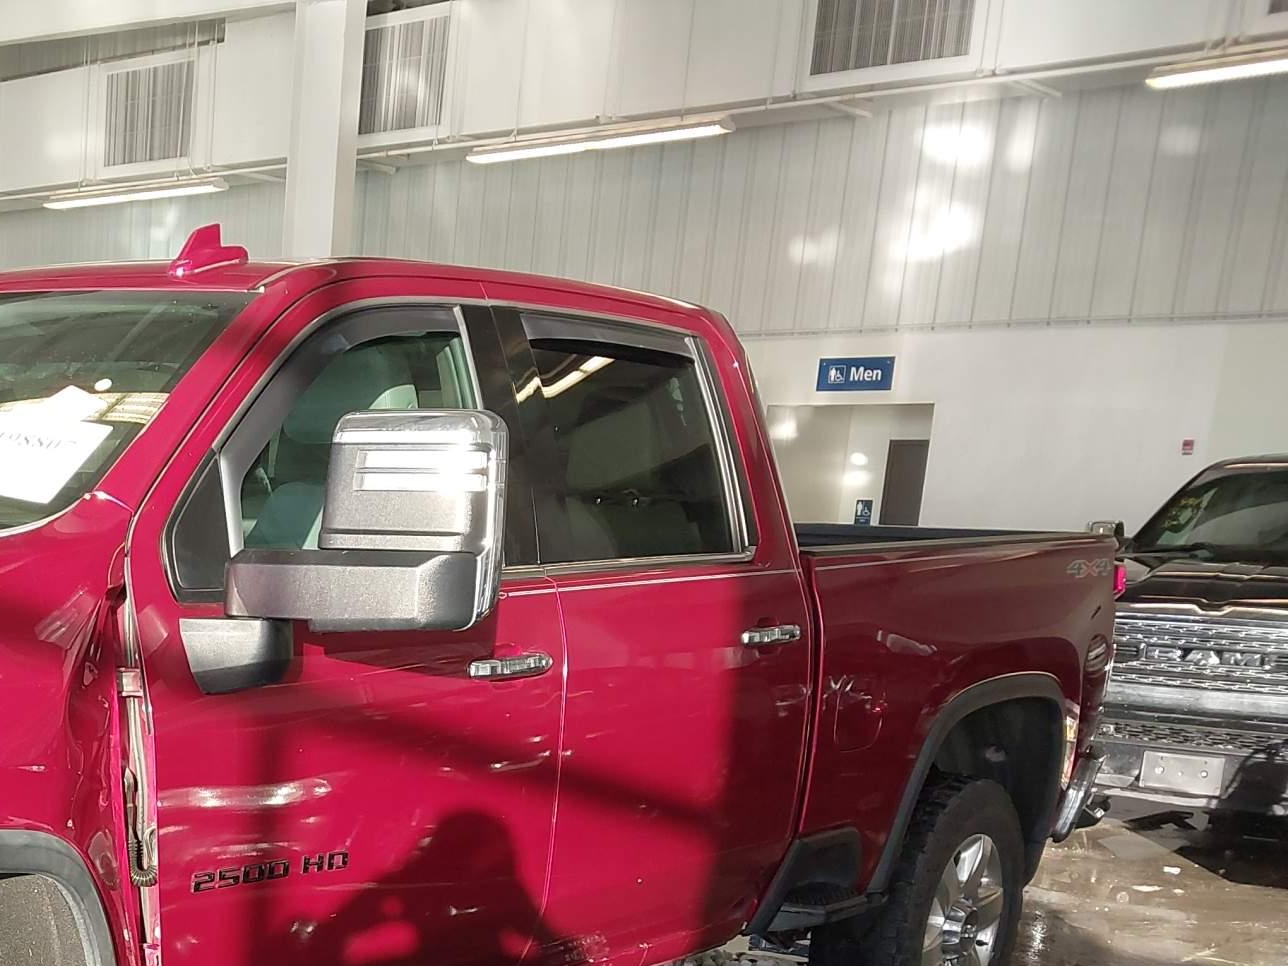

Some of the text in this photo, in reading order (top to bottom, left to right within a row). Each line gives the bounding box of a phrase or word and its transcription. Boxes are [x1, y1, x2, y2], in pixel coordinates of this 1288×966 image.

[849, 366, 882, 382] Men
[190, 849, 350, 894] 2500 HD
